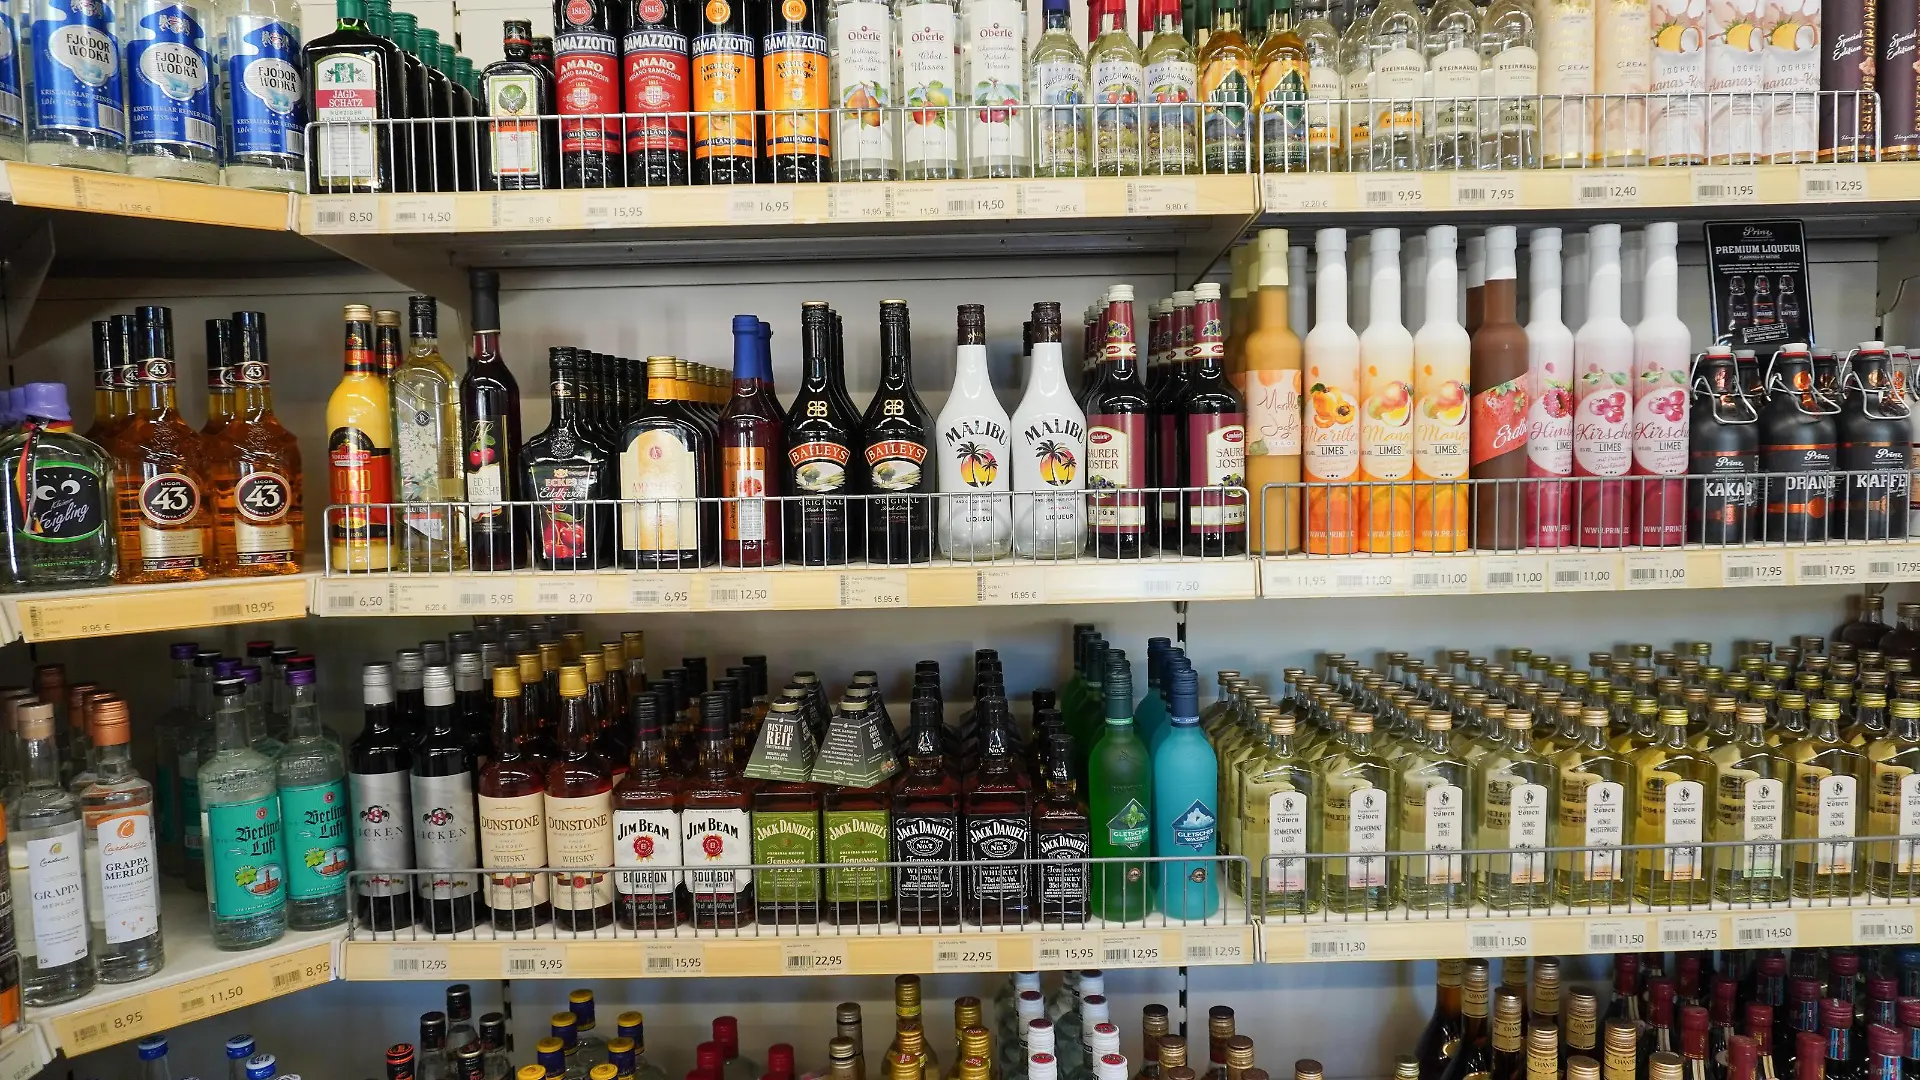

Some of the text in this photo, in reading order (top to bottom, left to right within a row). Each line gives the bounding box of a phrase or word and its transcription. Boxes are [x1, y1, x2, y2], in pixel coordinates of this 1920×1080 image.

[848, 32, 881, 41] Oberle
[911, 33, 945, 42] Oberle
[980, 29, 1013, 38] Oberle
[1835, 30, 1863, 48] Special
[1889, 29, 1917, 48] Special
[66, 33, 110, 53] FJODOR
[763, 35, 827, 53] RAMAZZOTTI
[68, 44, 110, 64] WODKA
[1832, 45, 1862, 61] Edition
[1886, 44, 1916, 61] Edition
[155, 51, 198, 69] FJODOR
[632, 57, 676, 73] AMARO
[156, 62, 198, 79] WODKA
[561, 59, 604, 75] AMARO
[258, 66, 297, 83] FJODOR
[260, 77, 296, 93] WODKA
[332, 90, 359, 99] JAGD-
[328, 98, 363, 107] SCHATZ
[1726, 185, 1754, 196] 11,95
[1835, 180, 1863, 191] 12,95
[1398, 190, 1422, 201] 9,95
[1490, 190, 1515, 200] 7,95
[1609, 186, 1637, 197] 12,40
[759, 201, 789, 212] 16,95
[977, 199, 1005, 211] 14,50
[349, 211, 373, 222] 8,50
[421, 211, 451, 222] 14,50
[612, 207, 643, 218] 15,95
[1715, 244, 1801, 255] PREMIUM LIQUEUR
[150, 362, 167, 376] 43
[246, 365, 262, 377] 43
[945, 420, 1008, 447] MALIBU
[1024, 418, 1085, 446] MALIBU
[869, 442, 924, 461] BAILEYS
[1321, 446, 1344, 455] LIMES
[1379, 445, 1402, 455] LIMES
[1434, 445, 1457, 454] LIMES
[1599, 443, 1622, 452] LIMES
[1659, 442, 1682, 451] LIMES
[793, 444, 846, 461] BAILEYS
[1804, 450, 1830, 460] Prinz
[1875, 448, 1903, 458] Prinz
[1715, 457, 1744, 467] Prinz
[150, 487, 189, 511] 43
[244, 484, 280, 507] 43
[40, 501, 90, 532] Feigling
[1584, 570, 1610, 581] 11,00
[1658, 568, 1685, 579] 11,00
[1755, 566, 1782, 576] 17,95
[1829, 565, 1856, 575] 17,95
[1365, 575, 1392, 585] 11,00
[1440, 573, 1467, 583] 11,00
[1516, 572, 1543, 582] 11,00
[1176, 581, 1200, 592] 7,50
[490, 594, 514, 604] 5,95
[569, 593, 593, 603] 8,70
[664, 592, 688, 602] 6,95
[740, 589, 767, 600] 12,50
[1010, 592, 1030, 600] 15,95
[359, 596, 383, 607] 6,50
[245, 602, 275, 614] 18,95
[766, 732, 793, 747] REIF
[481, 815, 540, 831] DUNSTONE
[548, 814, 608, 831] DUNSTONE
[617, 819, 670, 841] JIM BEAM
[686, 818, 739, 840] JIM BEAM
[757, 820, 816, 841] JACK DANIEL'S
[829, 818, 888, 840] JACK DANIEL'S
[897, 820, 954, 841] JACK DANIEL'S
[969, 822, 1029, 843] JACK DANIEL'S
[1178, 828, 1214, 838] GLETSCHER
[250, 837, 277, 857] Luft
[1040, 836, 1089, 853] JACK DANIEL'S
[493, 854, 526, 863] WHISKY
[562, 854, 595, 863] WHISKY
[105, 857, 149, 872] GRAPPA
[105, 865, 150, 881] MERLOT
[34, 883, 80, 901] GRAPPA
[1691, 930, 1717, 940] 14,75
[1766, 928, 1792, 938] 14,50
[1887, 925, 1914, 935] 11,50
[1500, 936, 1527, 946] 11,50
[1618, 934, 1644, 944] 11,50
[1214, 946, 1241, 956] 12,95
[1339, 941, 1366, 952] 11,30
[963, 951, 992, 962] 22,95
[1065, 948, 1094, 959] 15,95
[1132, 948, 1158, 959] 12,95
[421, 960, 448, 970] 12,95
[540, 959, 563, 970] 9,95
[675, 957, 701, 968] 15,95
[815, 955, 842, 966] 22,95
[306, 961, 330, 977] 8,95
[210, 985, 243, 1004] 11,50
[114, 1011, 143, 1029] 8,95
